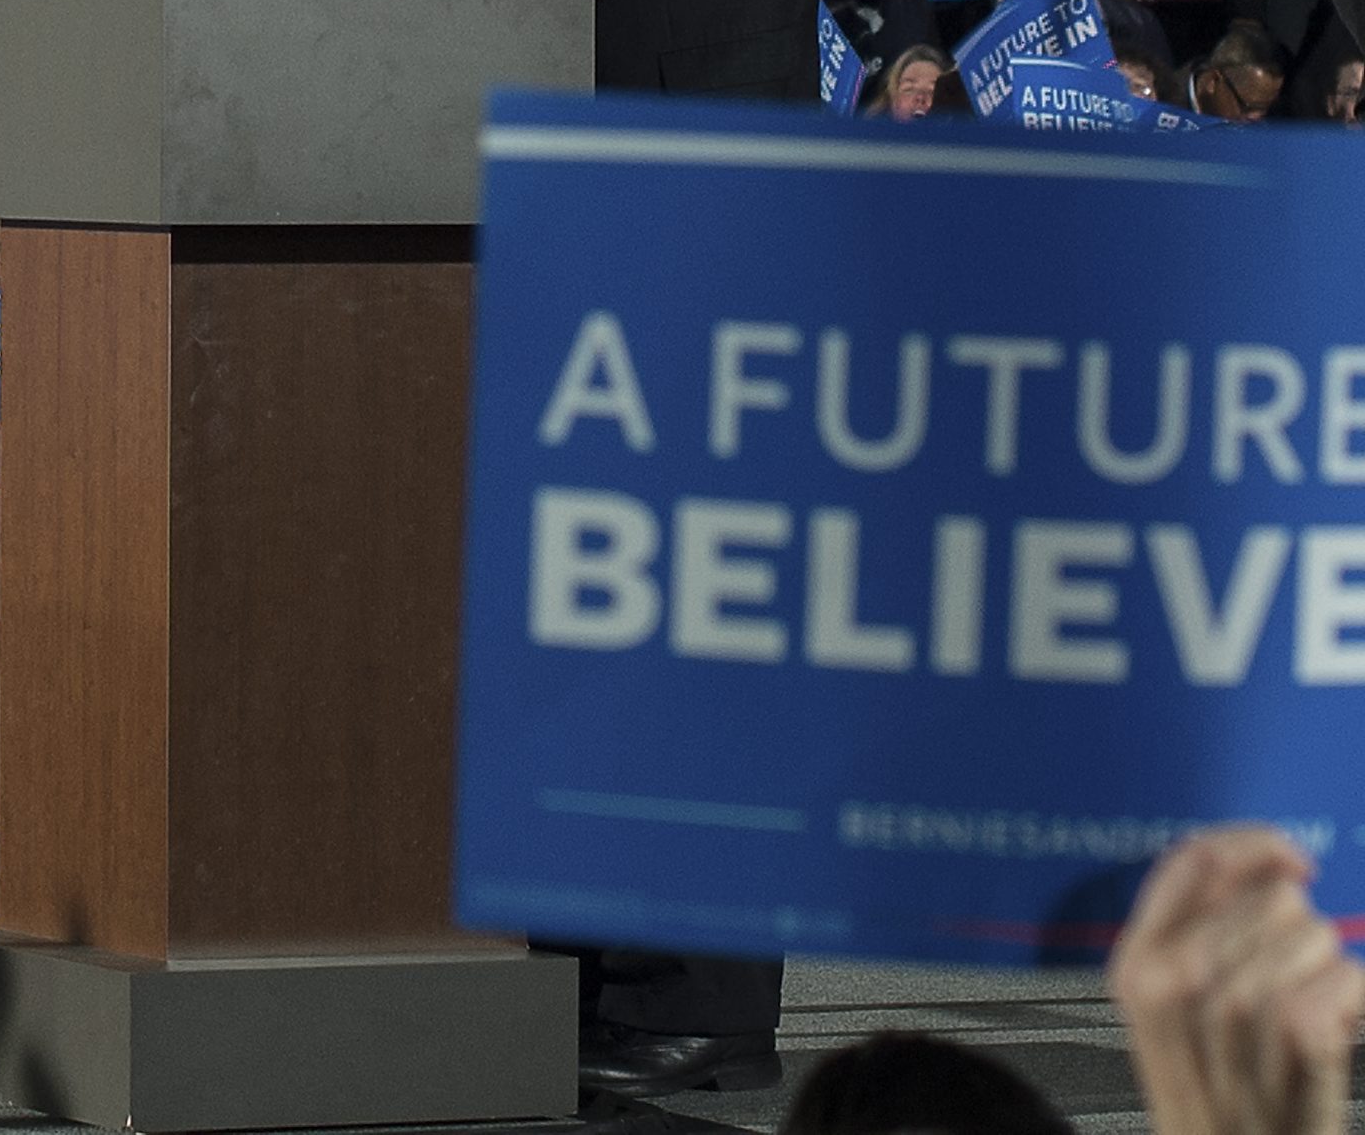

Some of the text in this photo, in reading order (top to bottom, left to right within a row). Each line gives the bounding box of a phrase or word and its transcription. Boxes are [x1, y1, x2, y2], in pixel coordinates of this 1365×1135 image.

[979, 17, 1053, 77] FUTURE
[1065, 14, 1098, 50] IN
[1045, 86, 1109, 116] FUTURE
[537, 307, 657, 454] A
